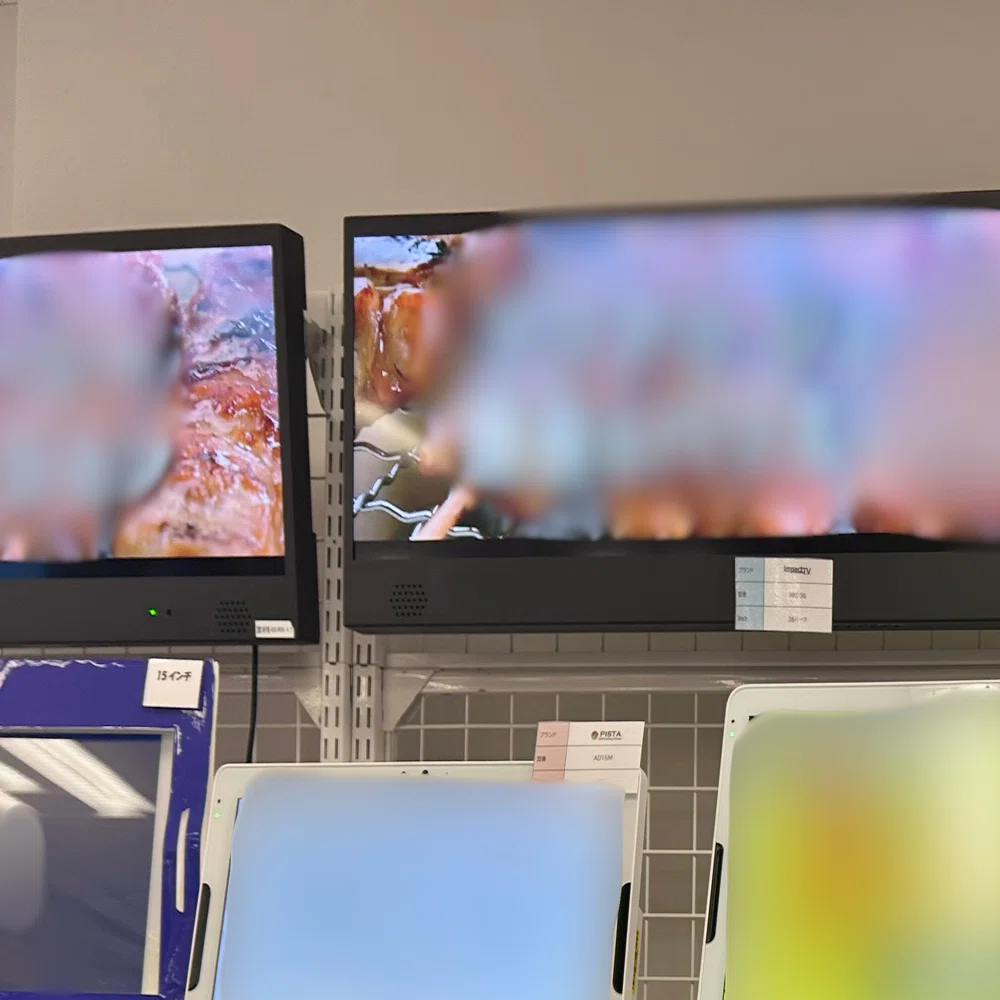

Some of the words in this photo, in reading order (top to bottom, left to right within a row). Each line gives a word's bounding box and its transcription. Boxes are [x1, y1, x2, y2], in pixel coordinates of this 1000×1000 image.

[157, 670, 192, 681] 15インチ
[600, 730, 622, 738] PISTA
